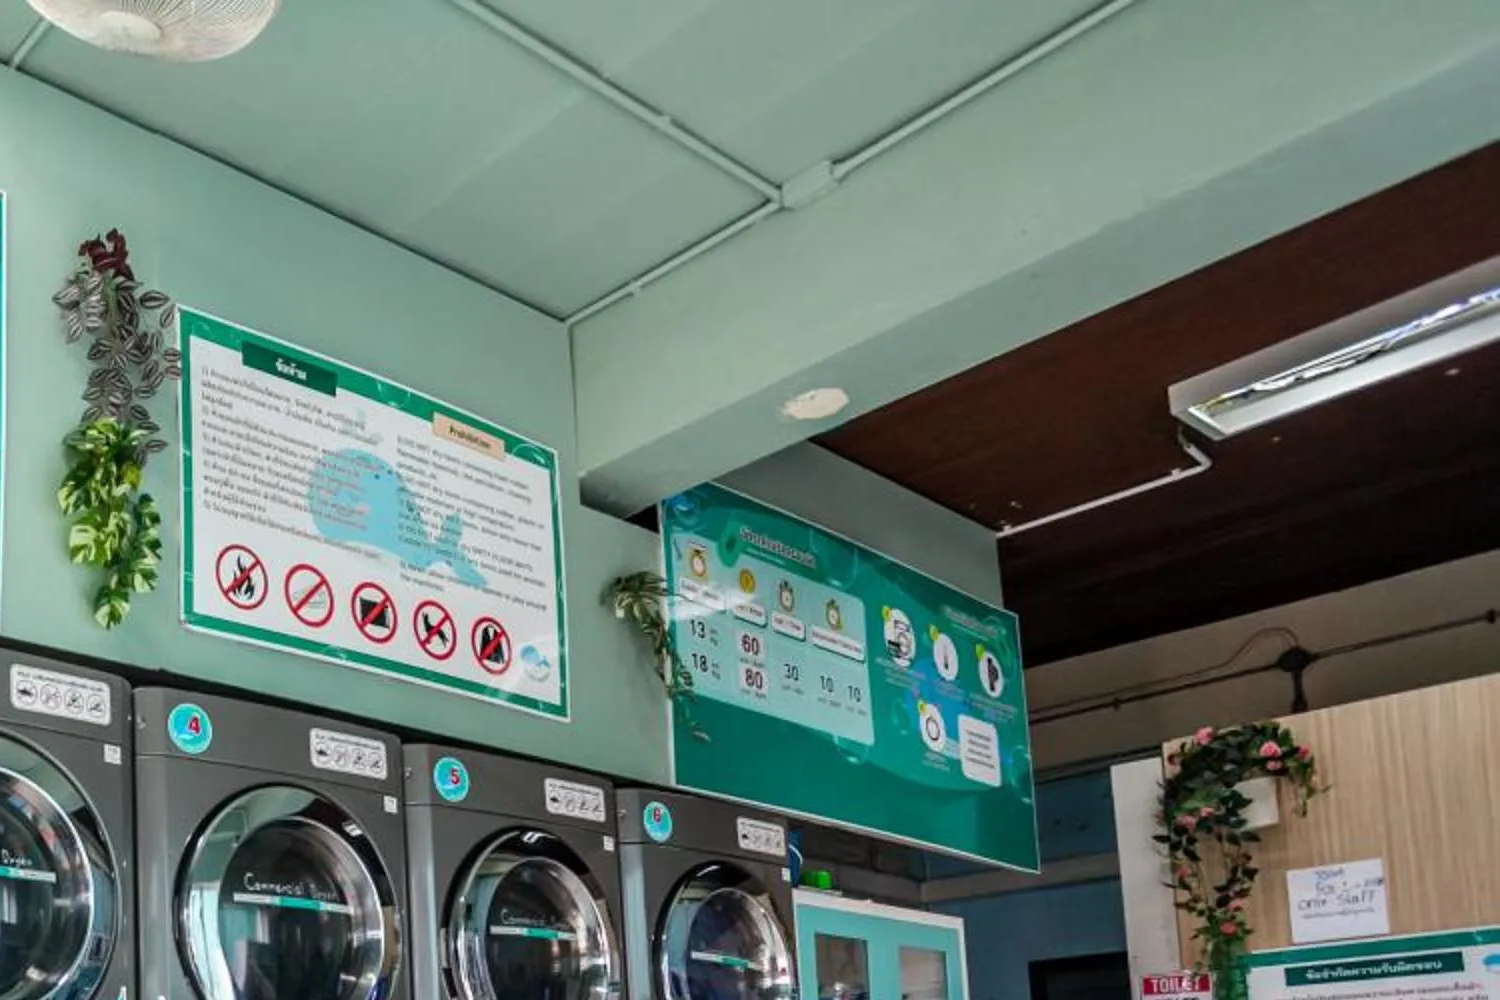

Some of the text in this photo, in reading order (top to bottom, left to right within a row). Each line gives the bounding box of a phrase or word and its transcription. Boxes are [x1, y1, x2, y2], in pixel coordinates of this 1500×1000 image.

[690, 620, 706, 640] 13
[741, 634, 760, 656] 60
[692, 653, 709, 673] 18
[745, 668, 764, 690] 80
[820, 675, 835, 693] 10
[848, 684, 862, 702] 10
[187, 715, 200, 733] 4
[450, 768, 461, 785] 5
[1150, 976, 1199, 993] TOILET
